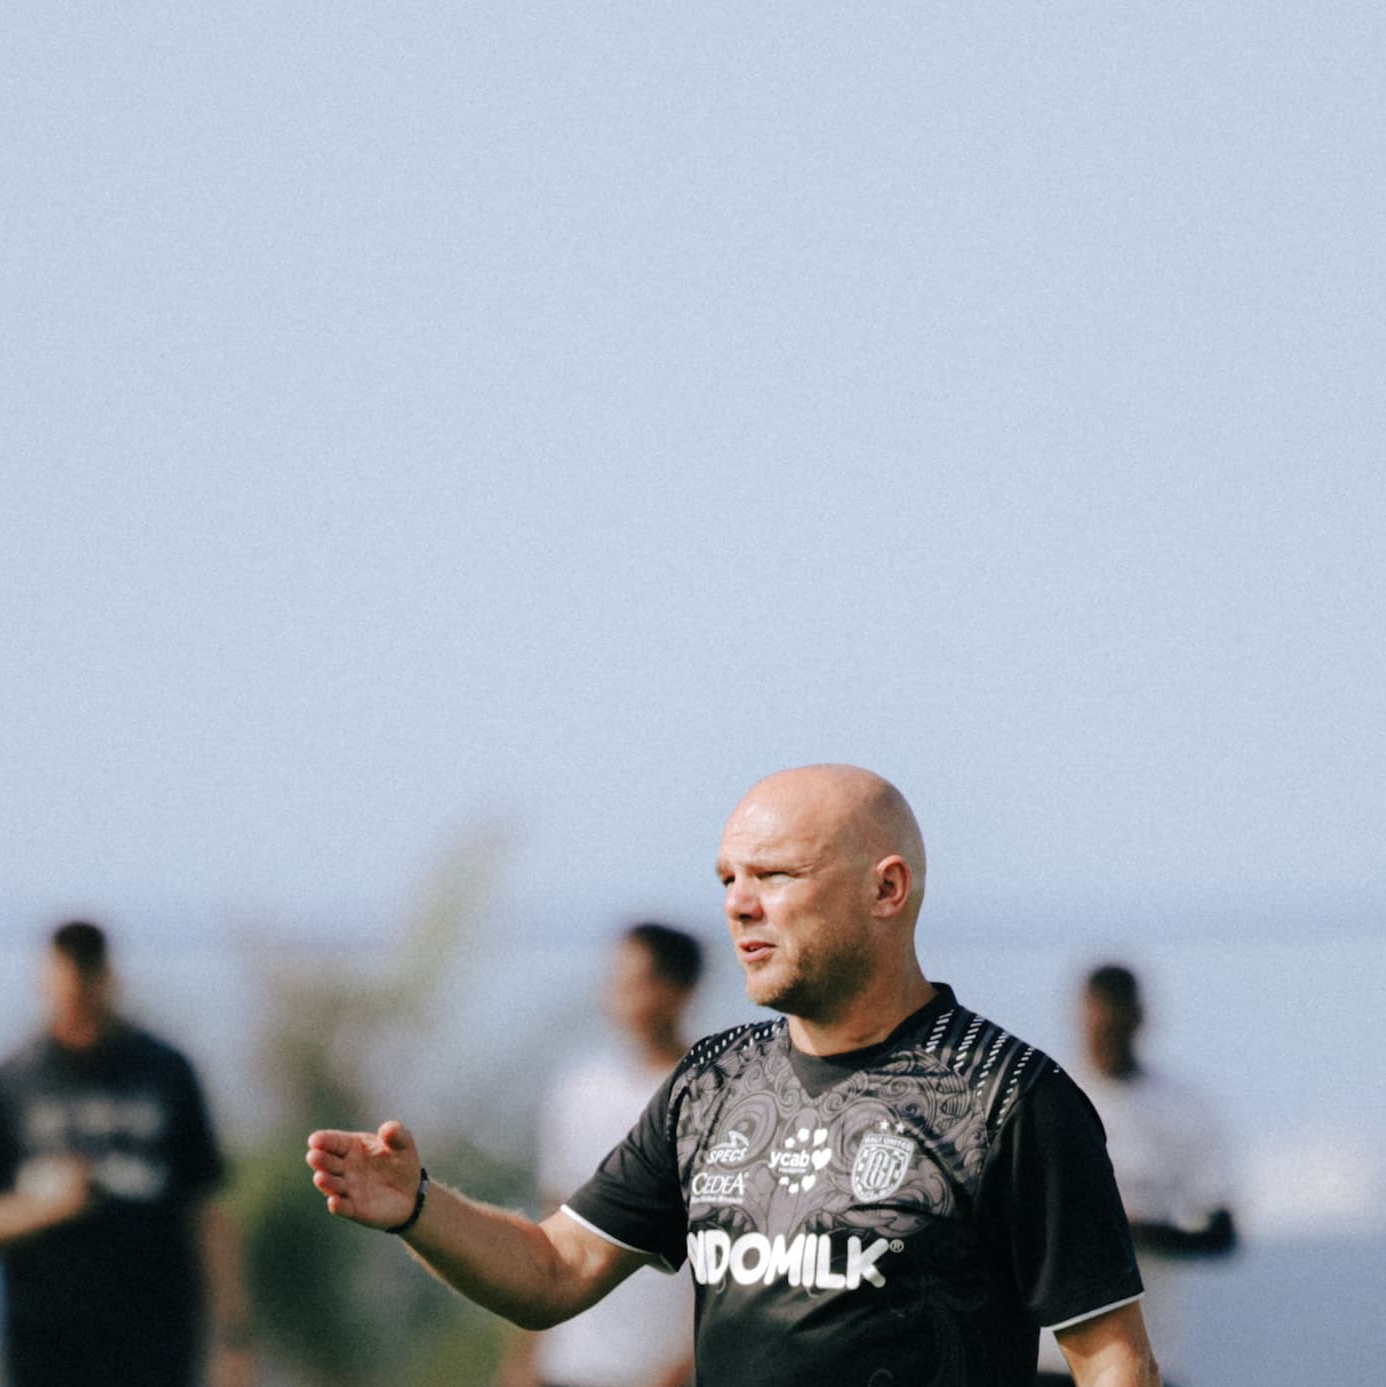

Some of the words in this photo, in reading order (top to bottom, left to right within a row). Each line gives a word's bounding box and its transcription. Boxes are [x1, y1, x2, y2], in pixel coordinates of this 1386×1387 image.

[707, 1148, 748, 1164] SPECS
[768, 1149, 810, 1168] ycab
[692, 1172, 745, 1195] CEDEA
[686, 1229, 889, 1290] NDOMILK
